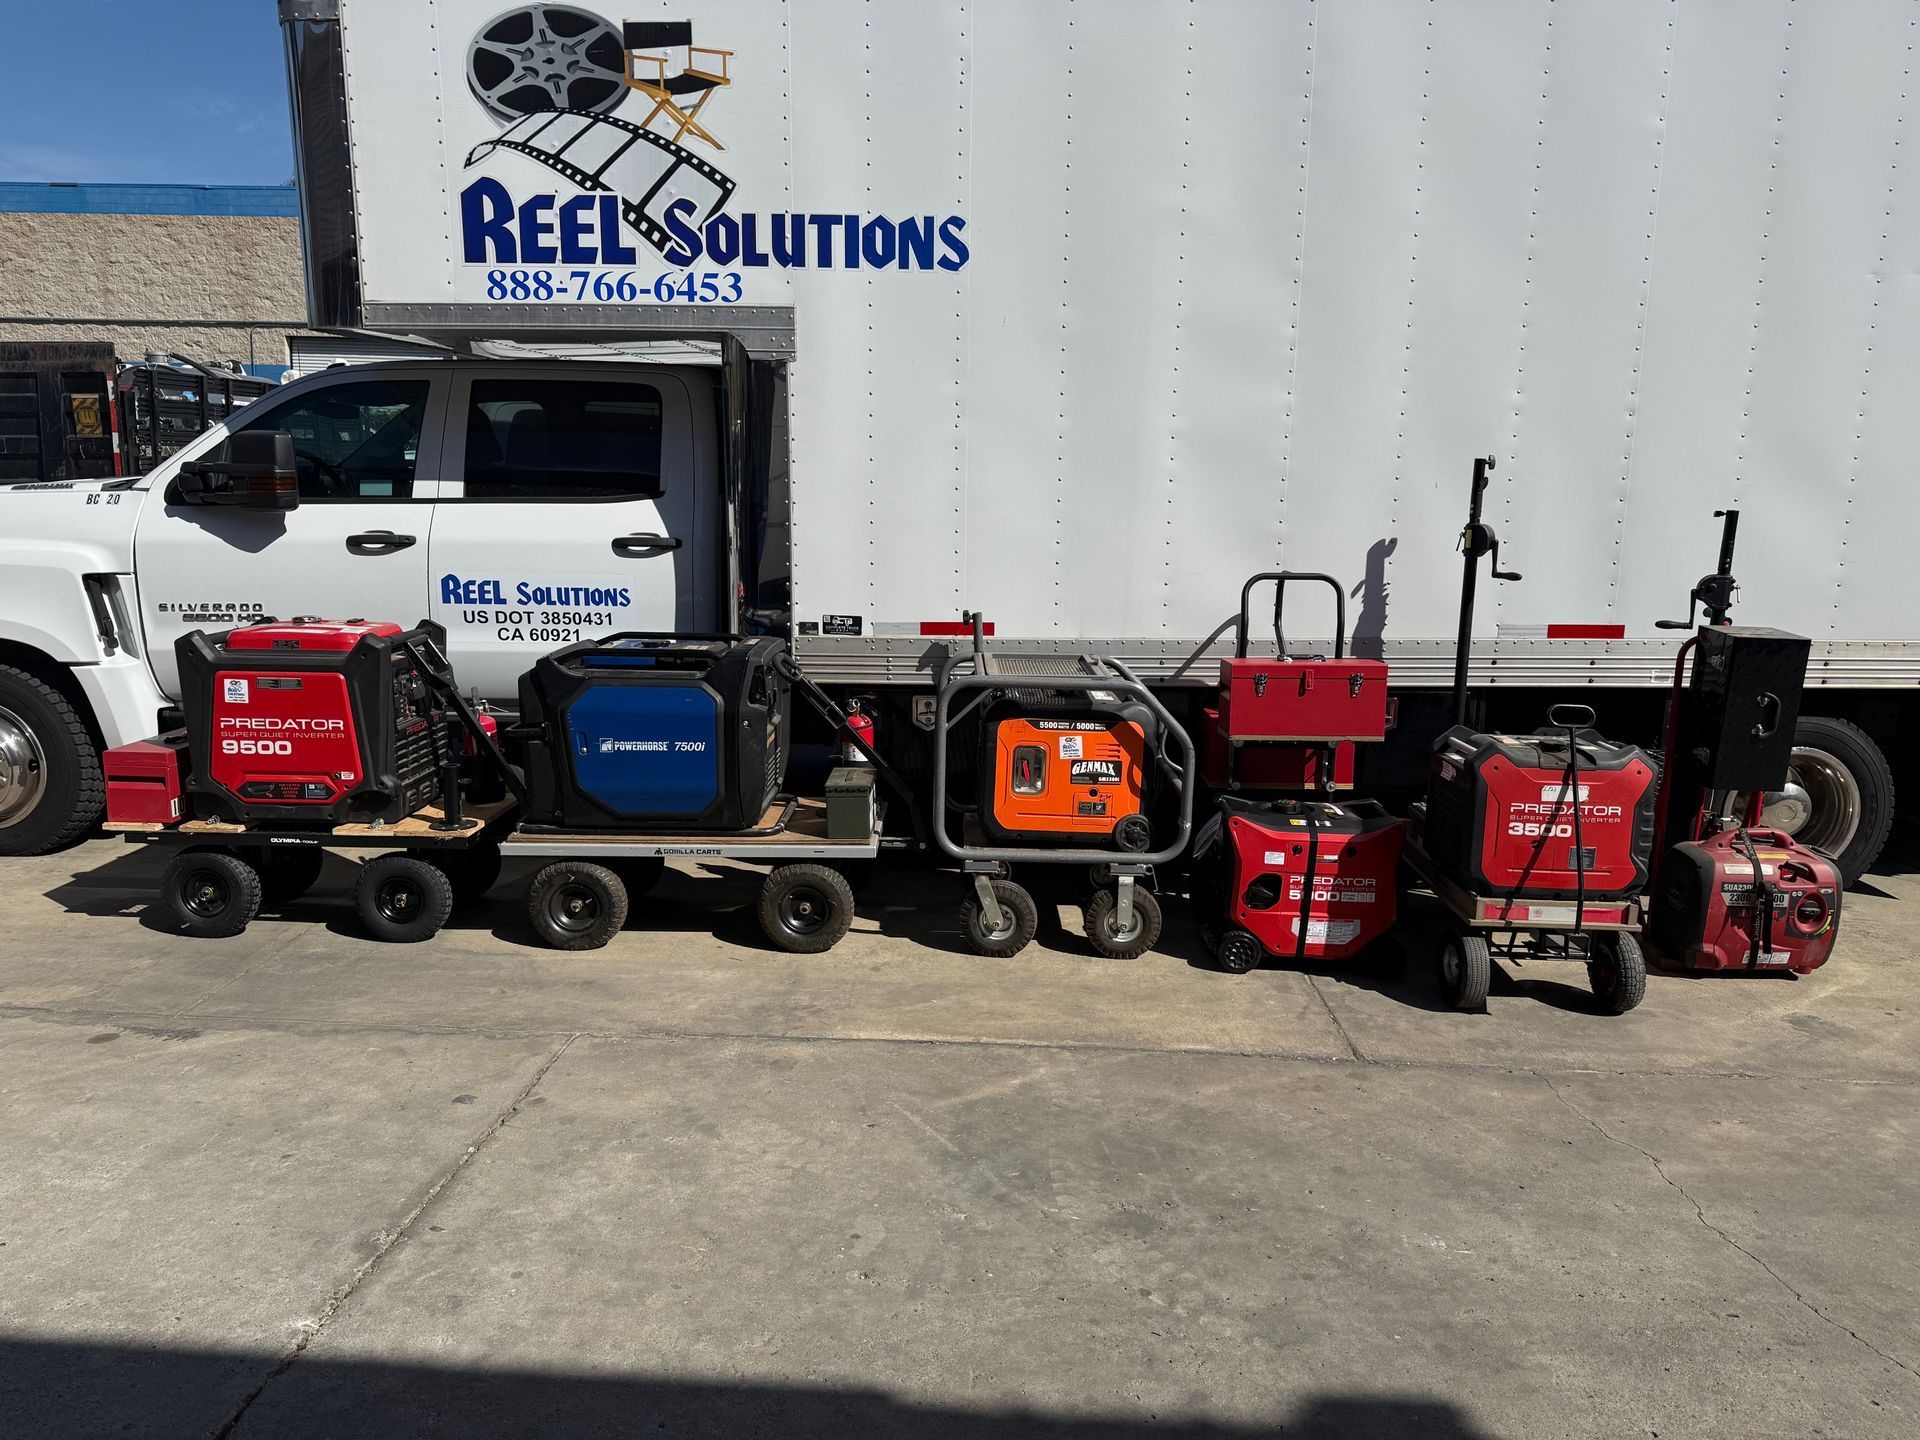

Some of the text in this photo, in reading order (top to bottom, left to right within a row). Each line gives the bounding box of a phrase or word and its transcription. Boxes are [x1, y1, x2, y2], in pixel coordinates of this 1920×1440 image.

[460, 176, 970, 272] REEL SOLUTIONS
[487, 269, 743, 303] 888-766-6453
[86, 494, 120, 505] BC 20
[440, 573, 631, 607] REEL SOLUTIONS
[158, 603, 263, 612] SILVERADO
[463, 610, 613, 625] US DOT 3850431
[497, 628, 581, 642] CA 60921
[220, 717, 344, 731] PREDATOR
[1040, 721, 1058, 729] 5500
[222, 739, 293, 755] 9500
[614, 741, 706, 752] POWERHORSE 7500i
[1072, 760, 1116, 775] GENMAX
[1510, 802, 1622, 816] PREDATOR
[1508, 822, 1573, 838] 3500
[1729, 893, 1752, 902] 2300
